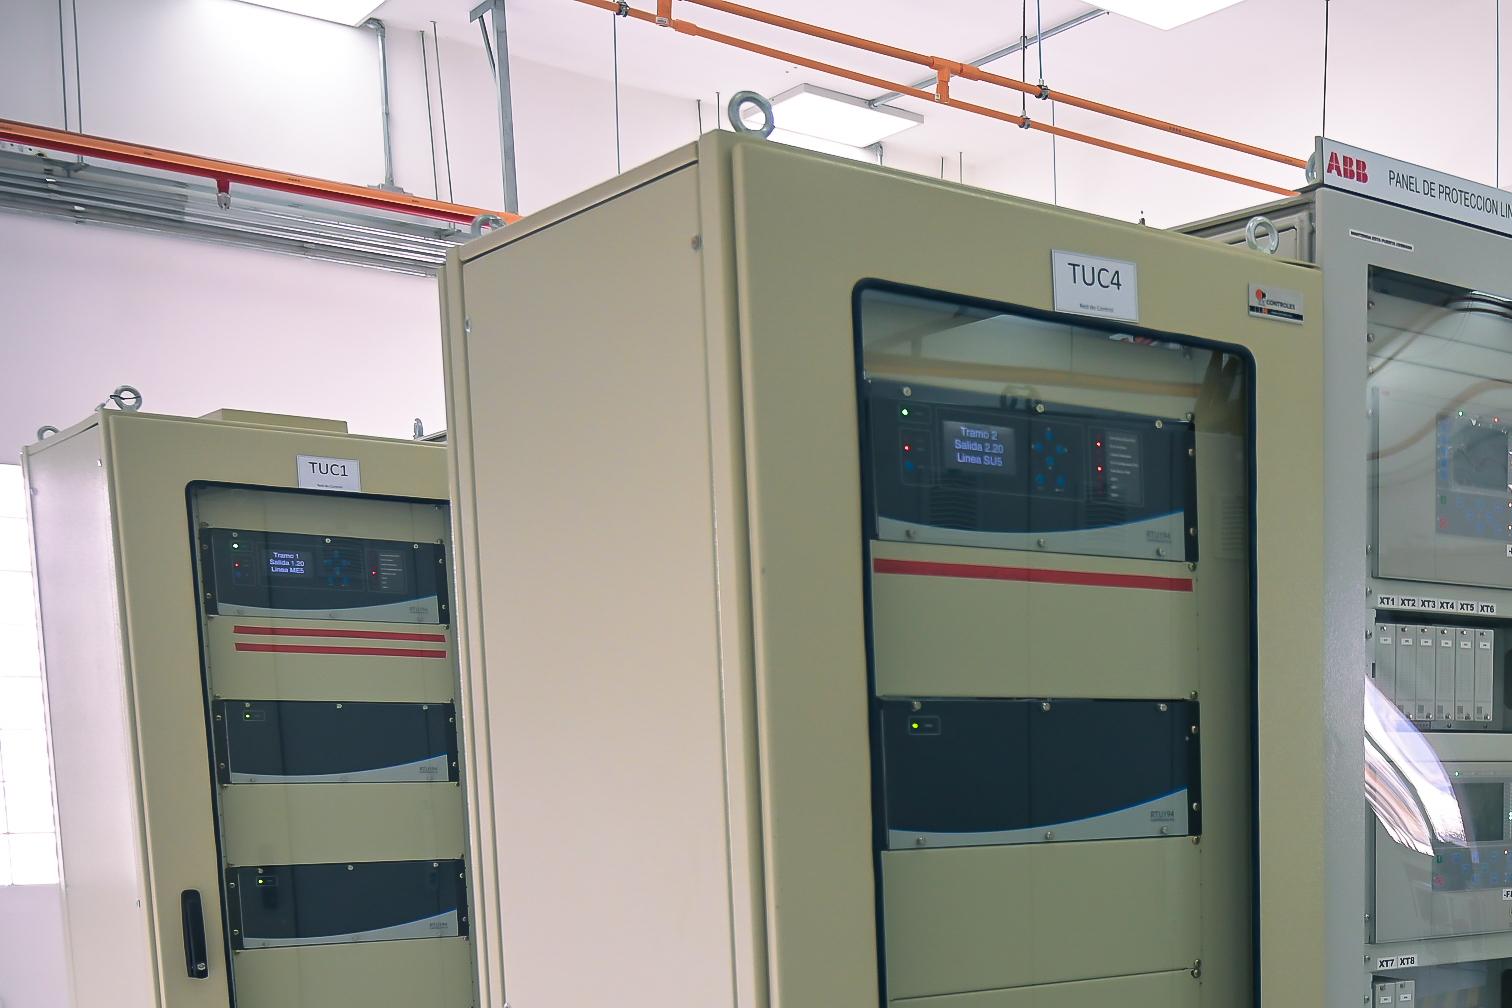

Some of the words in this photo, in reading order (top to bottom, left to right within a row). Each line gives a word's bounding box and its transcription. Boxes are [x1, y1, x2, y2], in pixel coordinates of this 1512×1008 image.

[1326, 151, 1369, 184] ABB
[1388, 169, 1421, 194] PANEL
[1423, 179, 1436, 198] DE
[1438, 184, 1499, 216] PROTECCION
[1067, 262, 1122, 291] TUC4
[960, 426, 990, 440] Tramo
[991, 431, 998, 441] 2
[954, 439, 983, 452] Salida
[984, 442, 1004, 454] 2.20
[308, 461, 349, 477] TUC1
[1379, 597, 1395, 606] XT1
[1400, 598, 1416, 607] XT2
[1420, 599, 1436, 609] XT3
[1440, 601, 1455, 610] XT4
[1460, 602, 1475, 611] XT5
[1480, 604, 1495, 613] XT6
[1379, 959, 1394, 968] XT7
[1400, 957, 1415, 966] XT8
